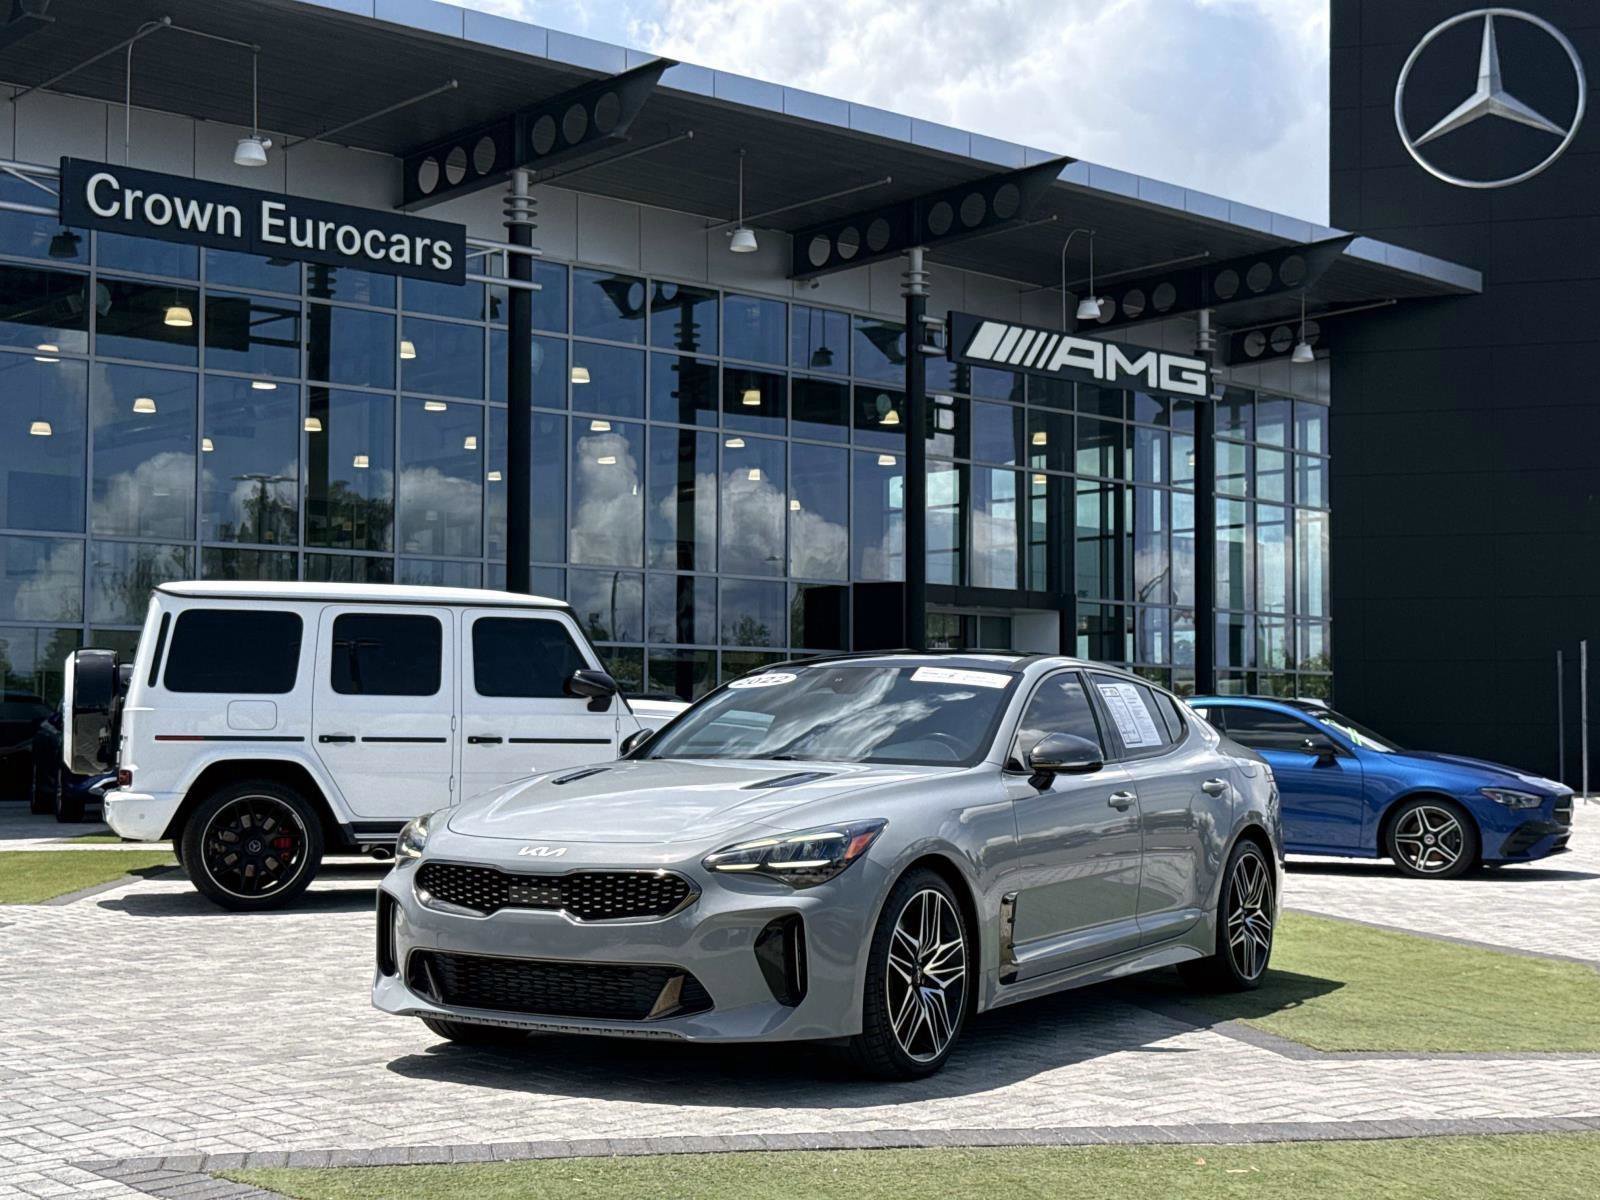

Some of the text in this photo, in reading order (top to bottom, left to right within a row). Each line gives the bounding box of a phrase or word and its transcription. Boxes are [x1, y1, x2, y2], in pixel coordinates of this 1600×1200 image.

[86, 172, 453, 271] Crown Eurocars
[1047, 336, 1206, 397] AMG
[518, 846, 567, 857] KIA
